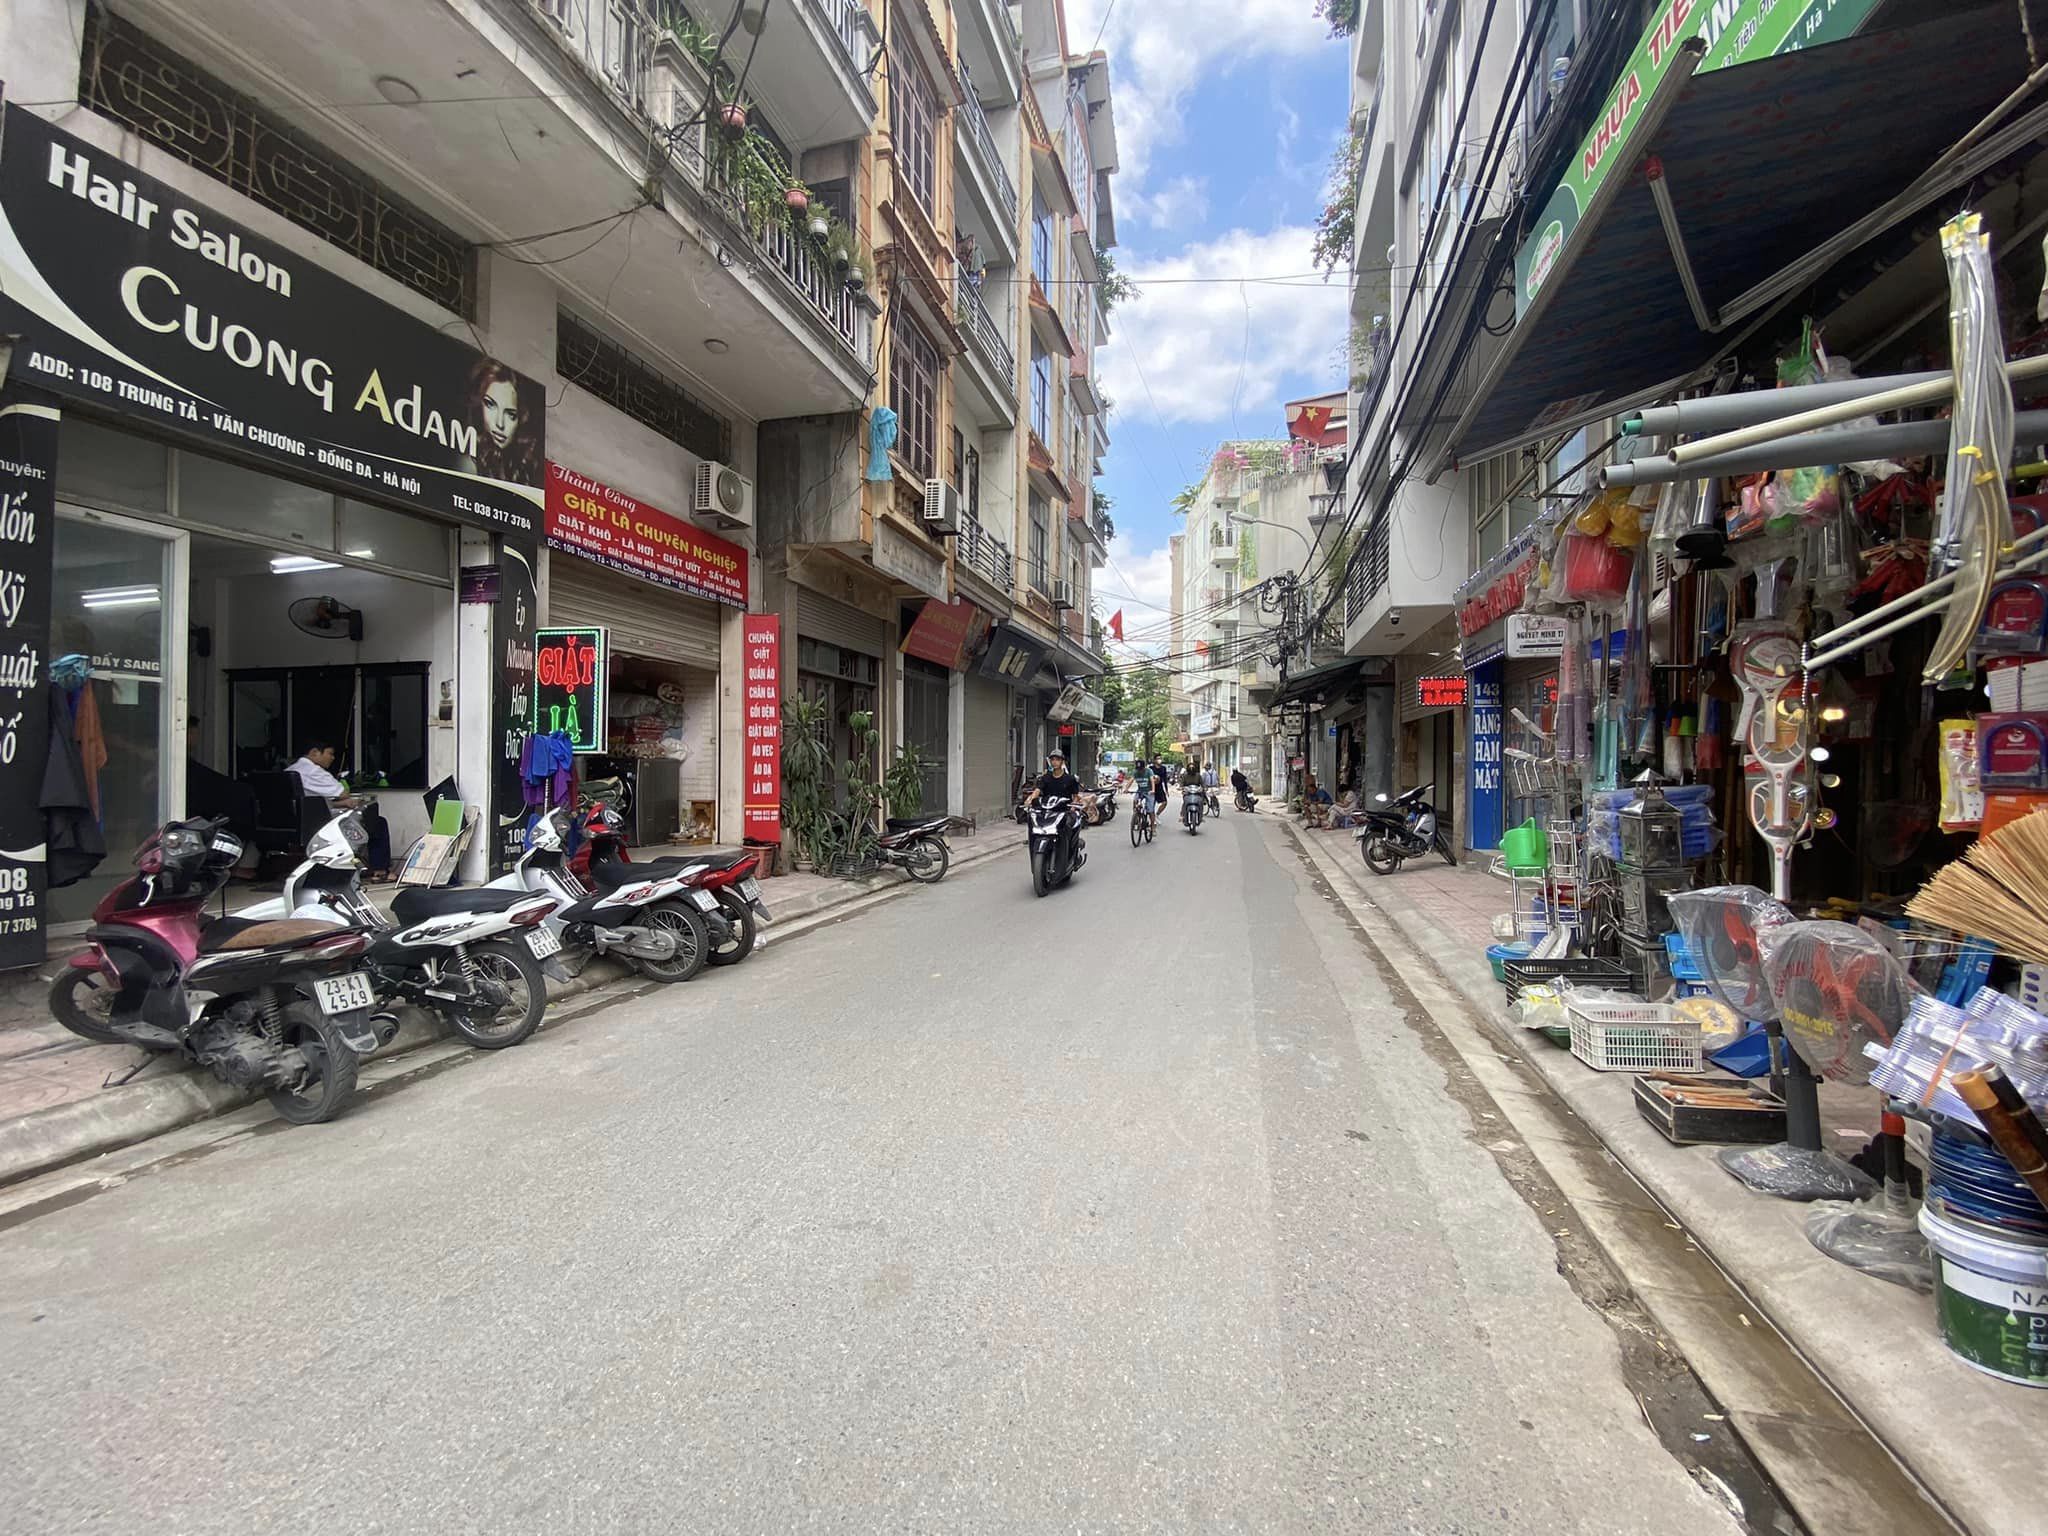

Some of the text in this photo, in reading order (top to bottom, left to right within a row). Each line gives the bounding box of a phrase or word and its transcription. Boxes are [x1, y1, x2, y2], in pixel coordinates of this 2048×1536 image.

[1583, 70, 1642, 184] NHỰA
[48, 141, 292, 299] Hair Salon
[28, 351, 421, 495] ADD: 108 TRUNG TẢ VĂN CHƯƠNG ĐỐNG ĐA HÀ NỘI
[552, 463, 637, 513] Thành Công
[452, 494, 532, 531] TEL: 038 317 3784
[563, 492, 737, 574] GIẶT LÀ CHUYÊN NGHIỆP
[588, 524, 611, 541] KHÔ
[576, 547, 596, 561] Trung
[748, 630, 775, 644] CHUYÊN
[753, 646, 770, 663] GIẶT
[123, 658, 160, 671] SANG
[538, 635, 596, 694] GIẶT
[766, 686, 776, 698] GA
[1474, 683, 1500, 697] 143
[1474, 709, 1501, 735] RĂNG
[752, 743, 774, 757] ÁO VEC
[1474, 736, 1500, 762] HÀM
[753, 761, 762, 776] ÁO
[752, 779, 761, 794] LÀ
[1474, 763, 1499, 794] MẶT
[18, 891, 36, 907] Tả
[12, 917, 38, 933] 3784
[330, 992, 369, 1011] 4549
